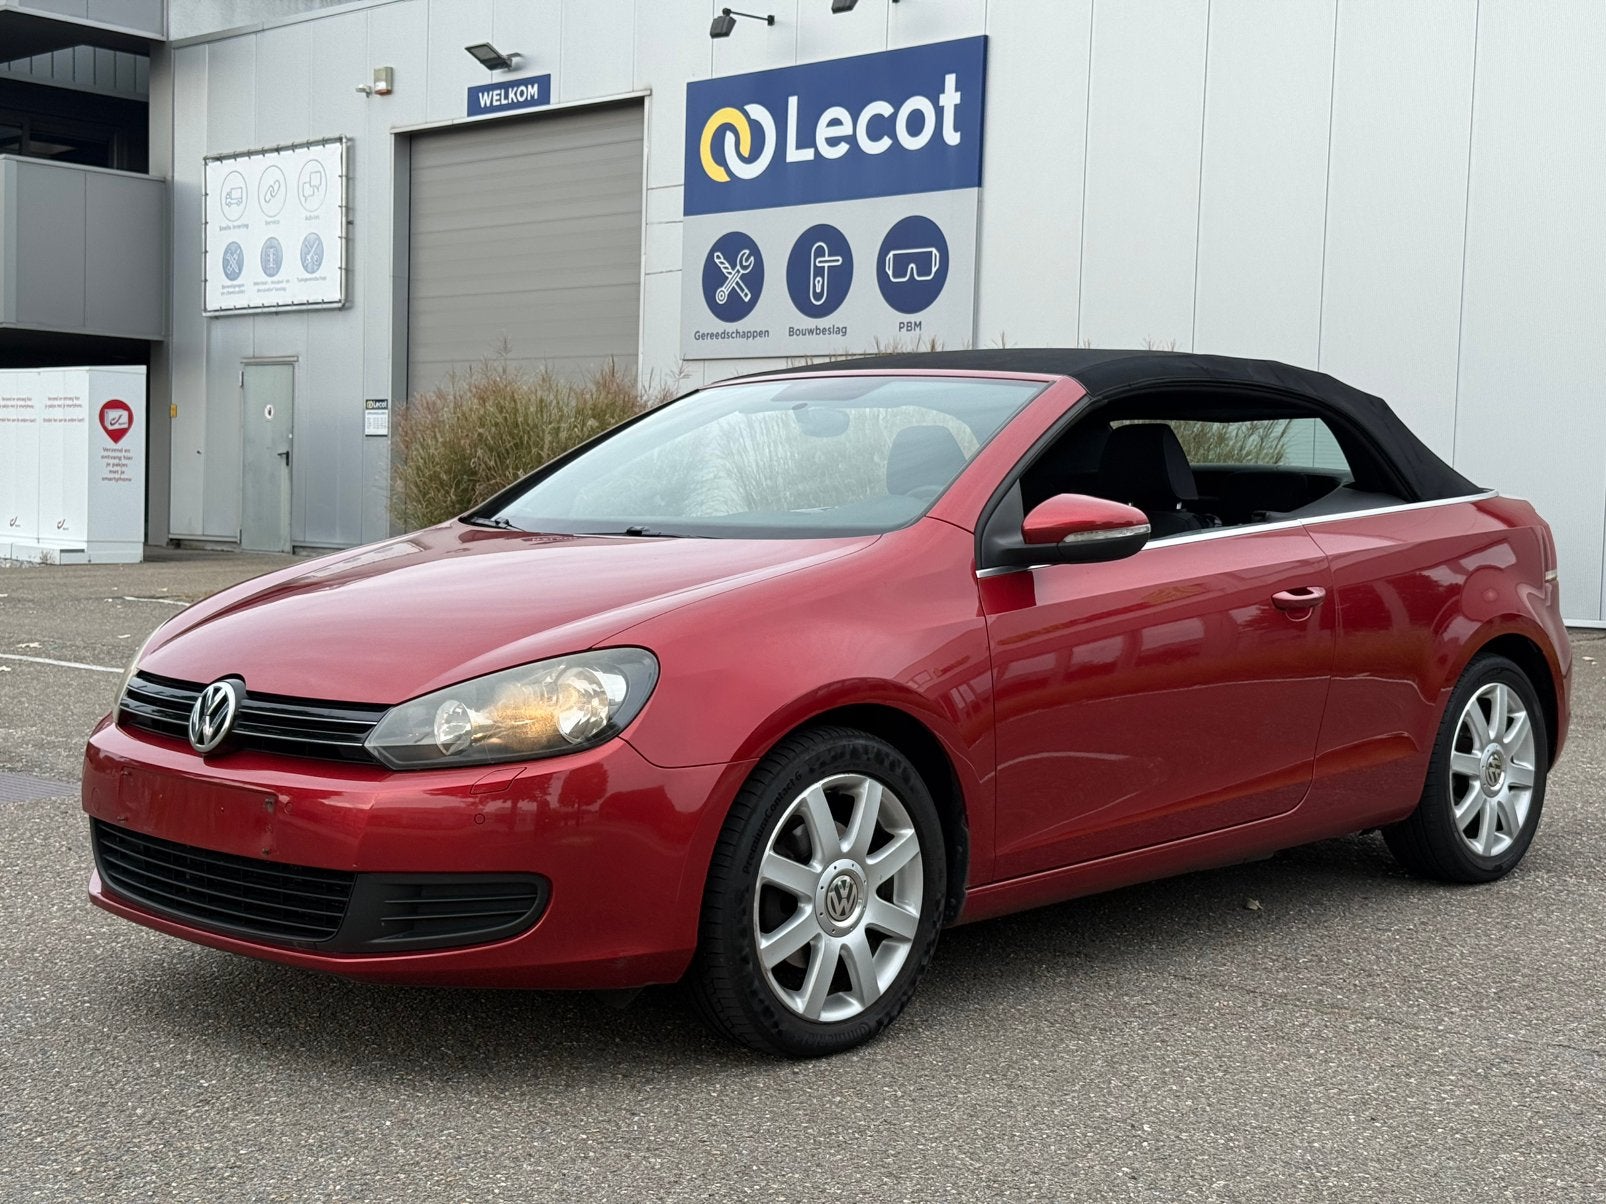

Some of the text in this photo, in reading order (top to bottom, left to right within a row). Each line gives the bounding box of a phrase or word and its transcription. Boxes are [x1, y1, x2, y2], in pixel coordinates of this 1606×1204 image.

[478, 83, 538, 108] WELKOM
[786, 73, 961, 163] Lecot
[788, 325, 847, 337] Bouwbeslag
[898, 321, 922, 332] PBM
[694, 328, 770, 341] Gereedschappen
[794, 770, 802, 780] 6
